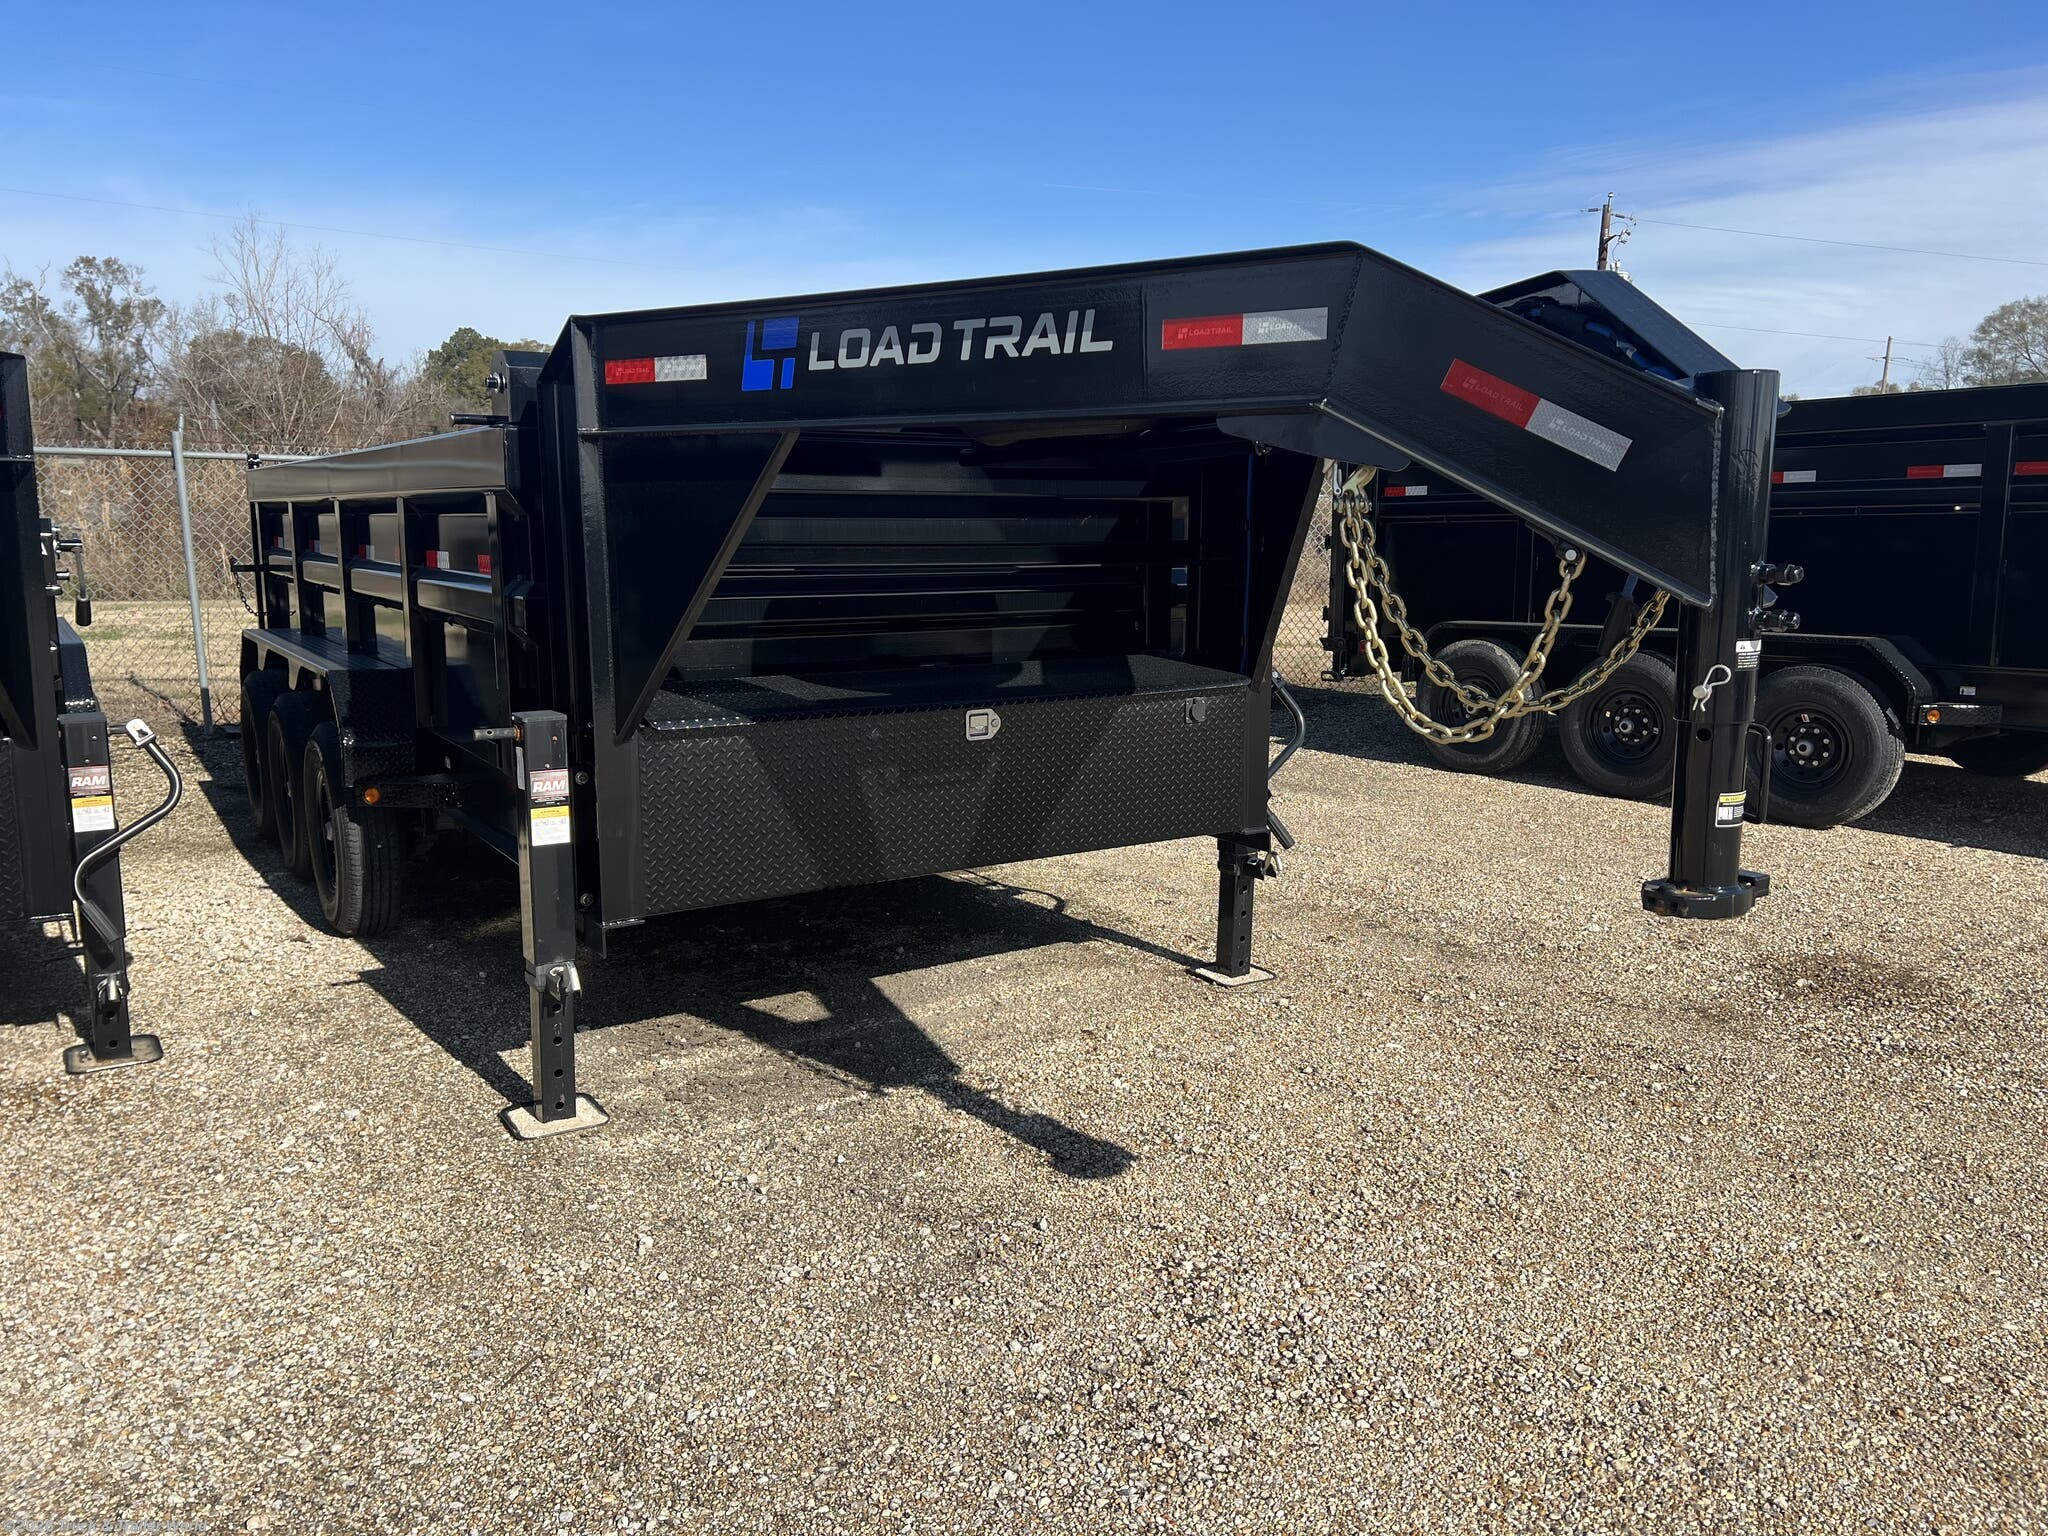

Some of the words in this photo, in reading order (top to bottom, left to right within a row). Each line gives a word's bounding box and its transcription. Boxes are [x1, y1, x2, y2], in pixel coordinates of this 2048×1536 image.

[1189, 328, 1210, 337] LOAD
[1210, 327, 1233, 336] TRAIL
[1270, 321, 1293, 331] LOAD
[808, 322, 943, 371] LOAD
[953, 309, 1114, 361] TRAIL
[1474, 384, 1499, 400] LOAD
[1500, 394, 1524, 412] TRAIL
[1562, 425, 1588, 441] LOAD
[1586, 435, 1614, 452] TRAIL
[71, 775, 106, 788] RAM
[532, 779, 566, 793] RAM
